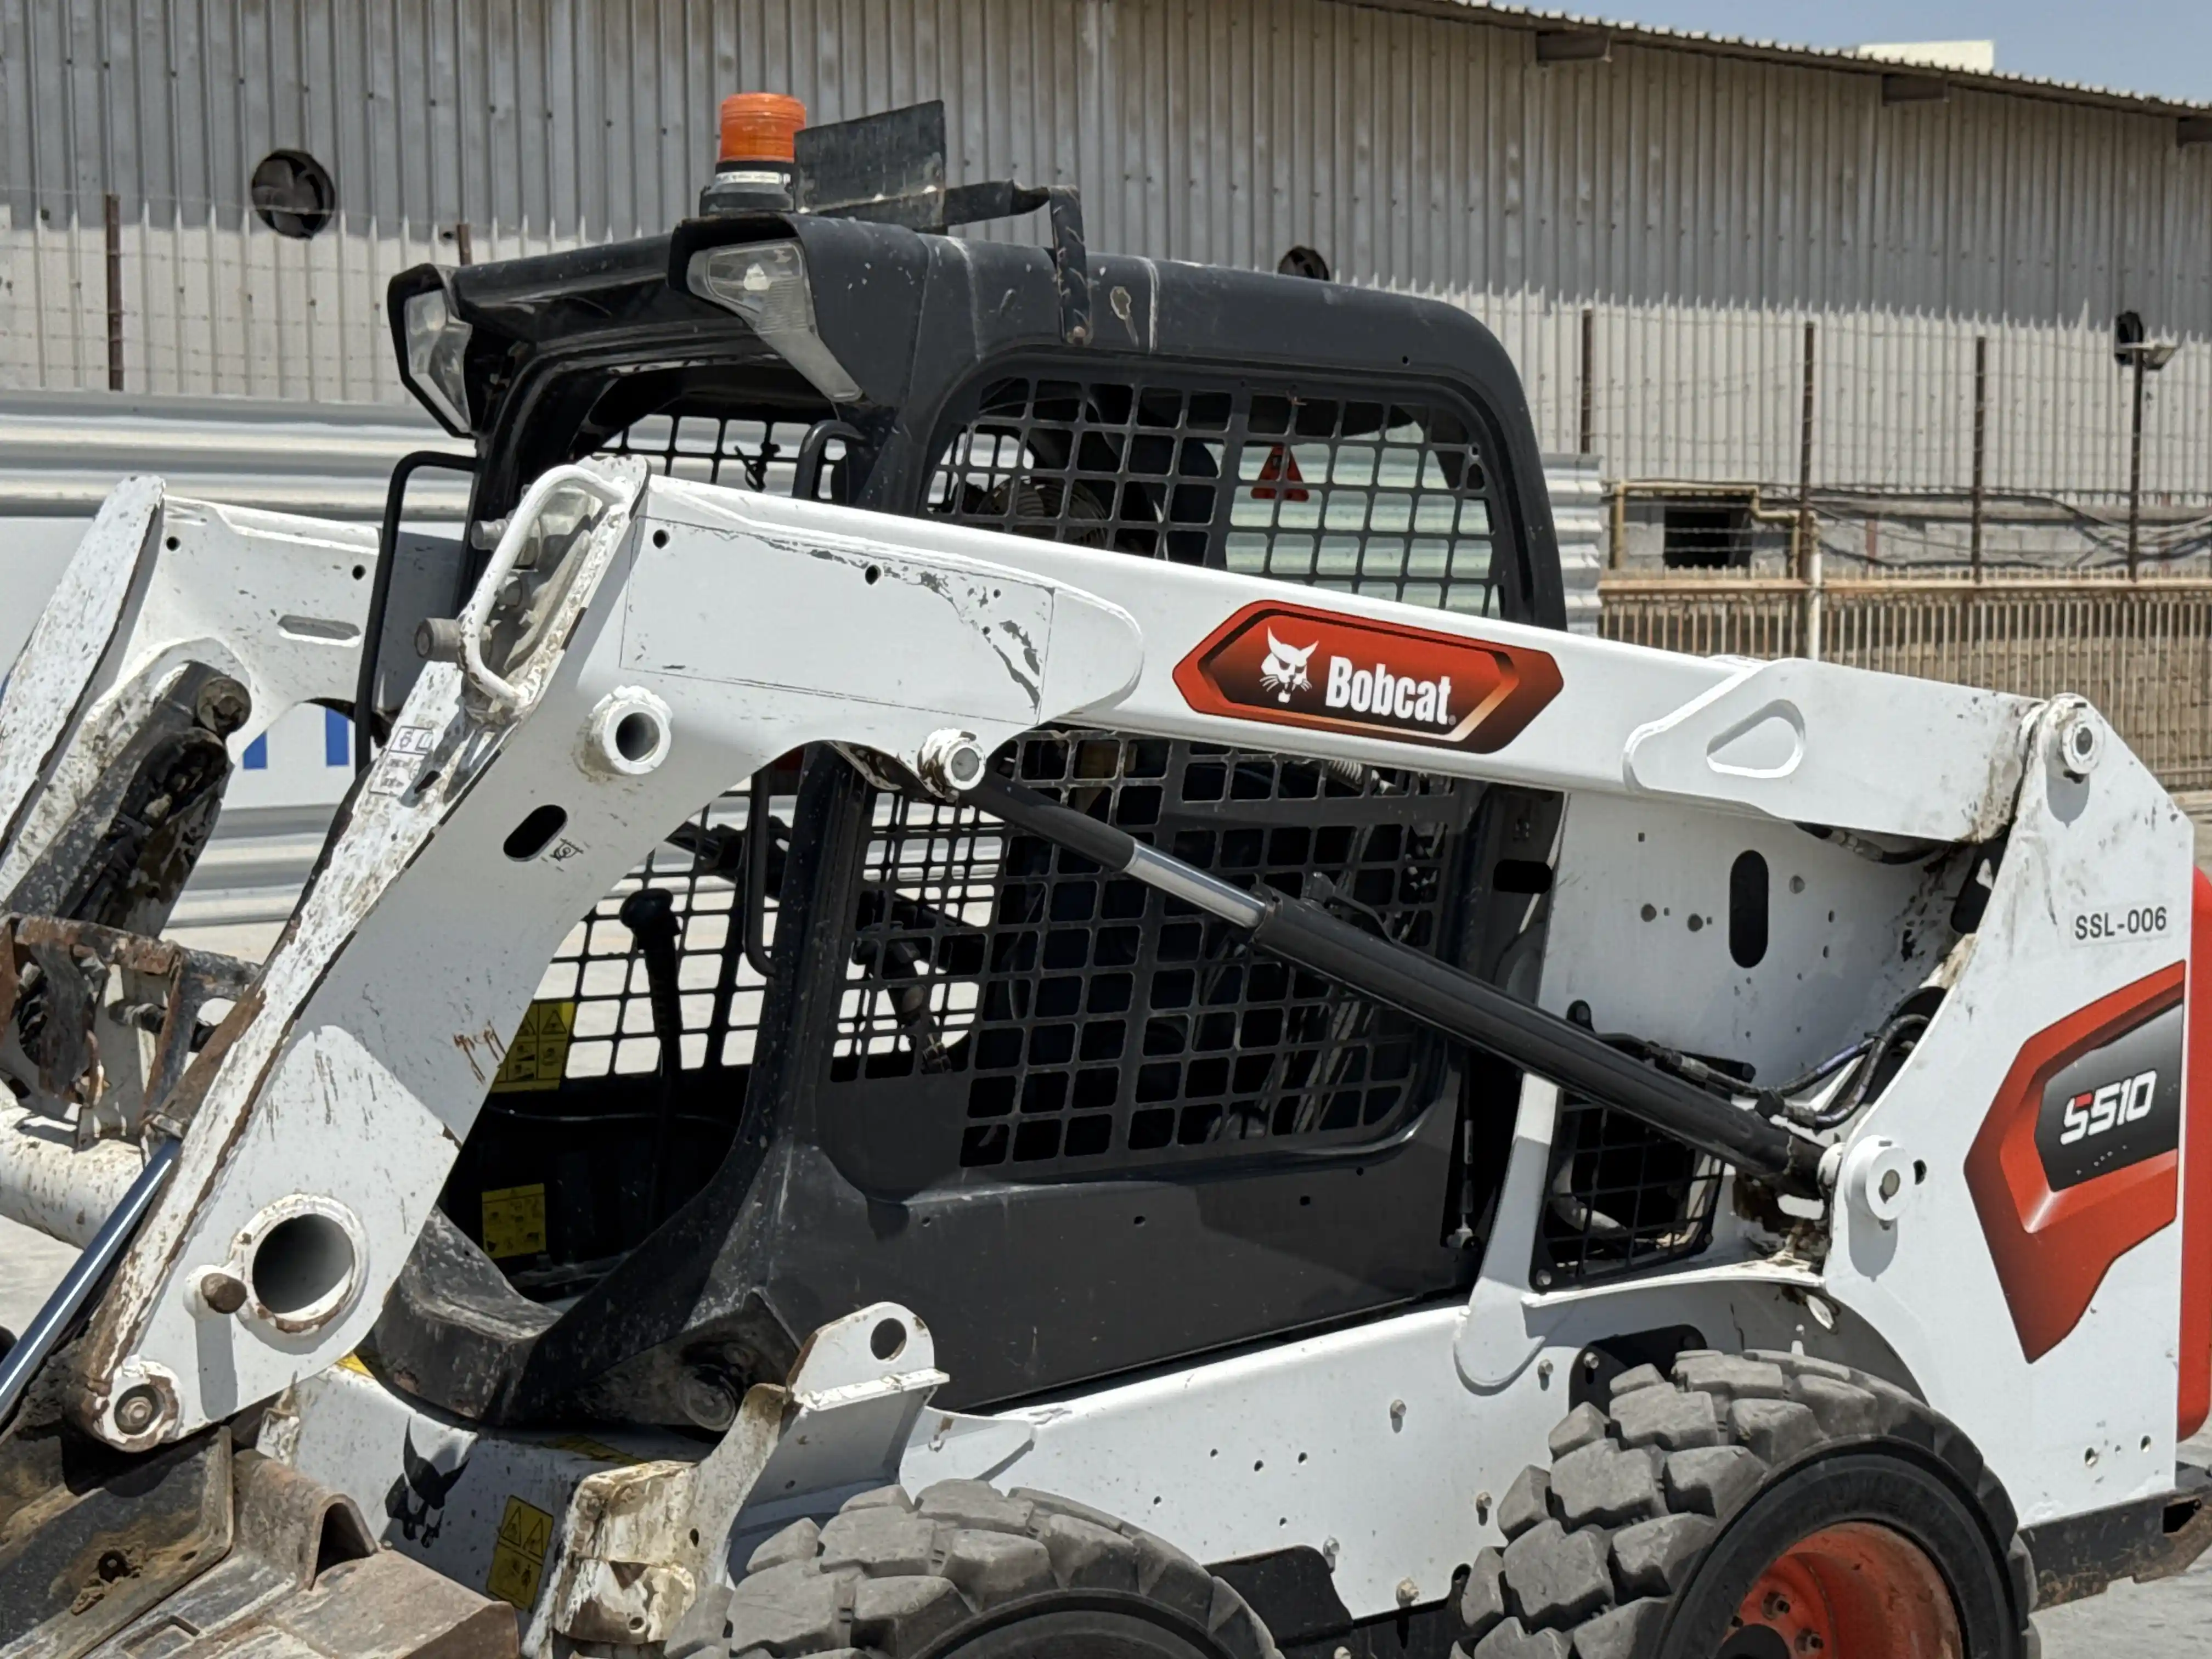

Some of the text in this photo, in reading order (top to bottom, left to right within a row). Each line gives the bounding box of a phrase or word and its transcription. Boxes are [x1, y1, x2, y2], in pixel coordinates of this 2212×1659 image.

[1325, 655, 1451, 725] Bobcat
[2075, 906, 2167, 940] SSL-006
[2060, 1070, 2157, 1145] S510
